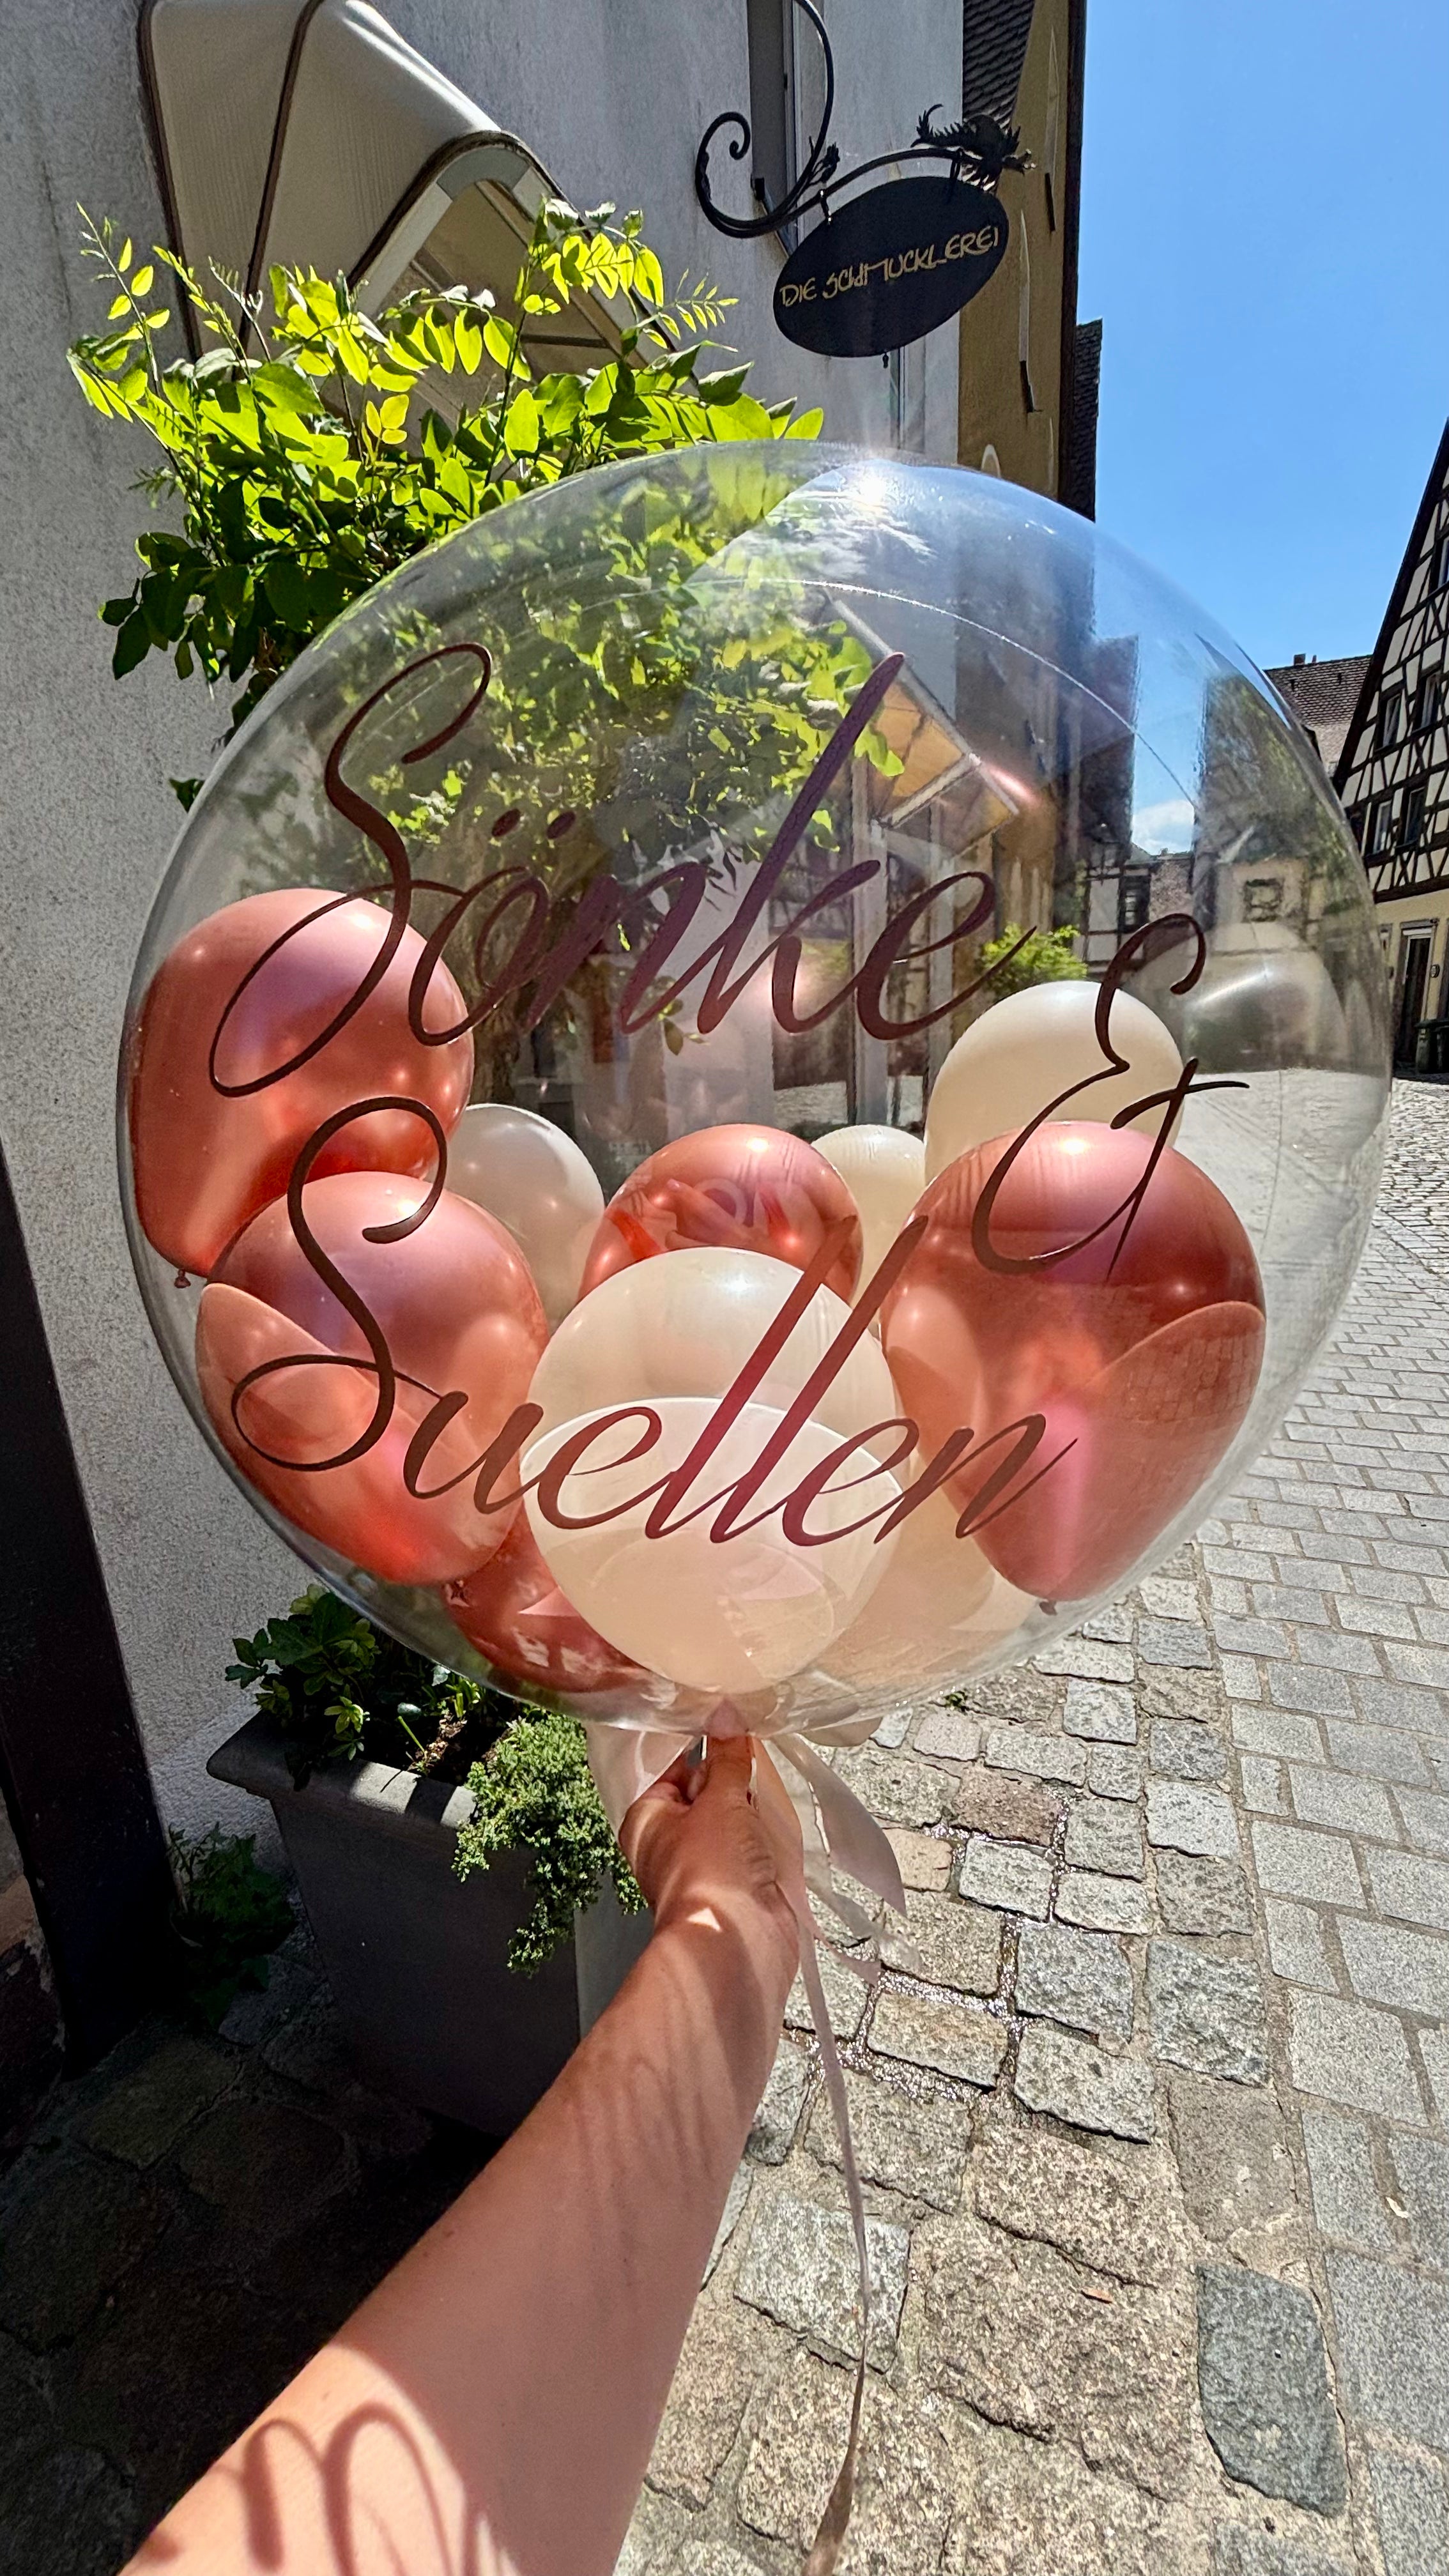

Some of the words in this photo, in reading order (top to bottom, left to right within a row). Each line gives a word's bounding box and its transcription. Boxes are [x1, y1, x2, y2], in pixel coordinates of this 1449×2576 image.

[779, 277, 817, 307] DIE
[822, 225, 999, 299] SCHMUCKLEREI
[209, 643, 1036, 1097] Sönke
[972, 913, 1250, 1280] &
[231, 1096, 1078, 1547] Suellen
